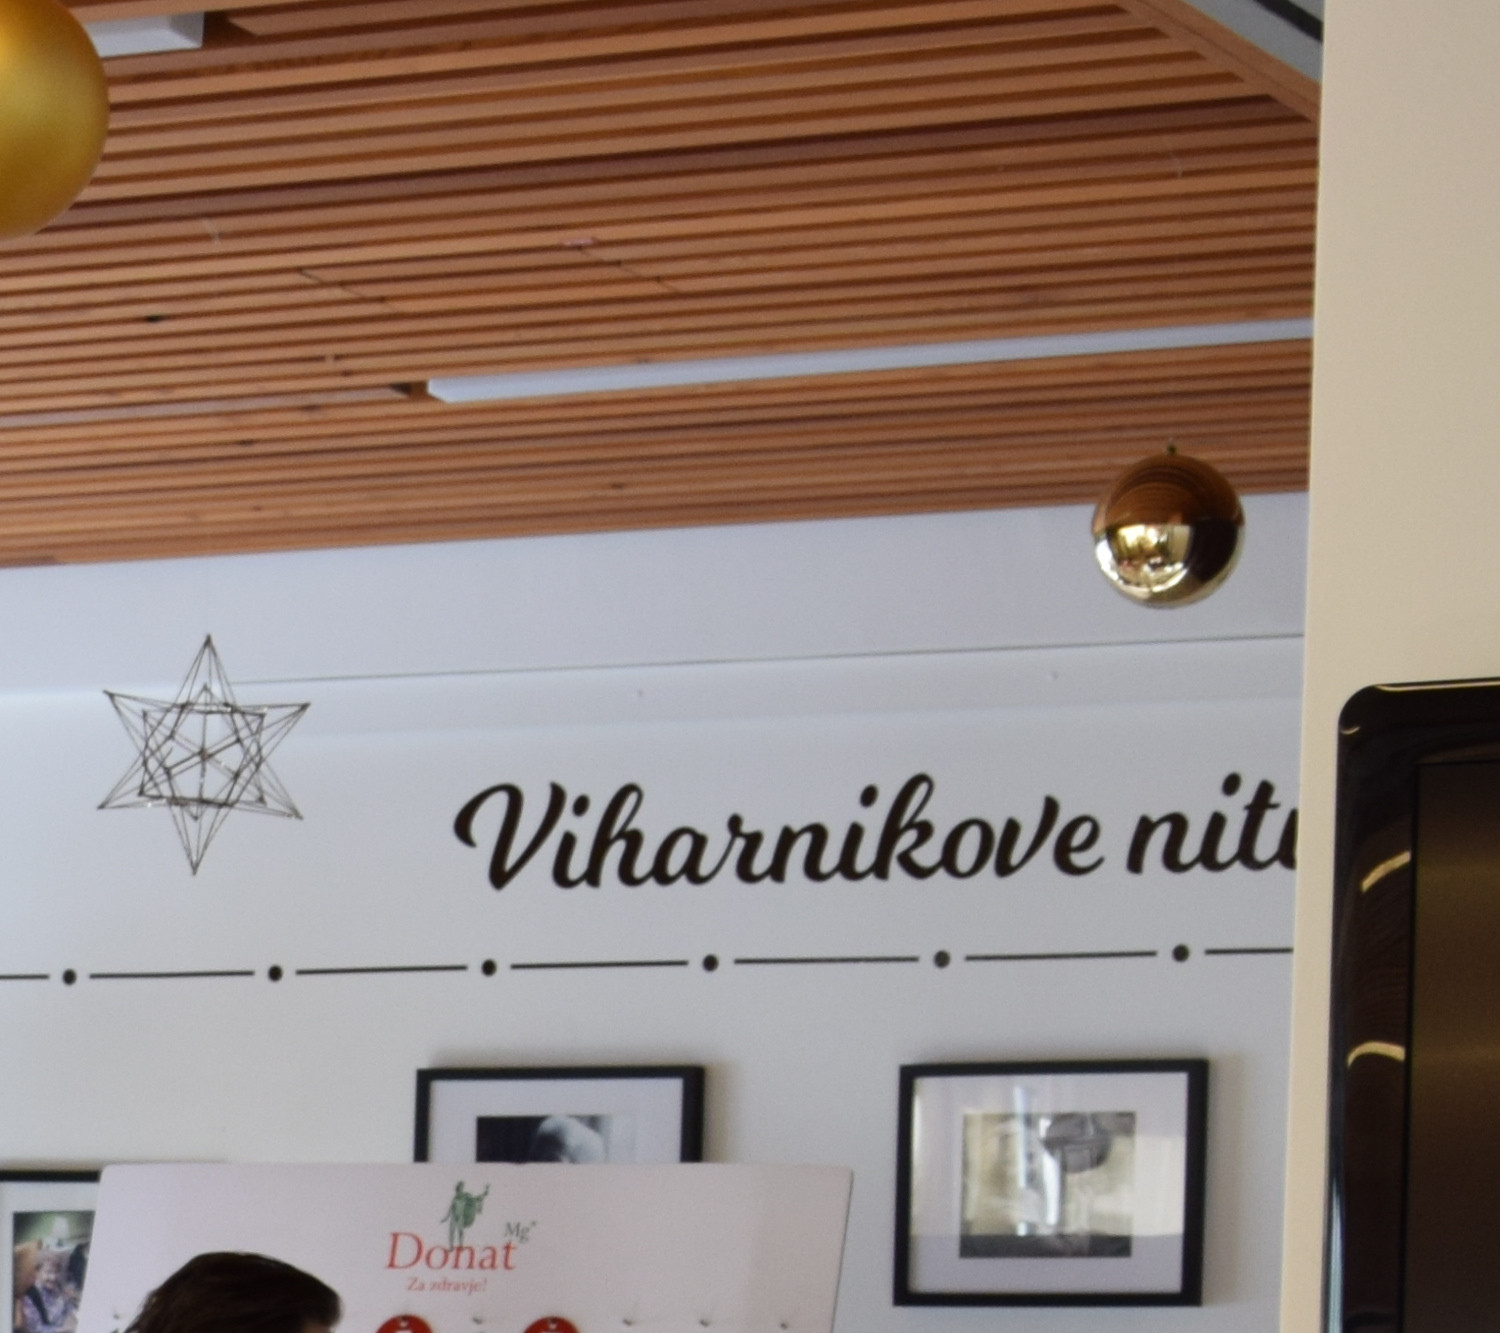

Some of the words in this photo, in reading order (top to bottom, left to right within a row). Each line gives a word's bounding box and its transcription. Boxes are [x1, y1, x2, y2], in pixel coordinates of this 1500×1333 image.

[453, 772, 1106, 891] Viharnikove
[385, 1232, 517, 1271] Donat
[406, 1277, 426, 1292] Za
